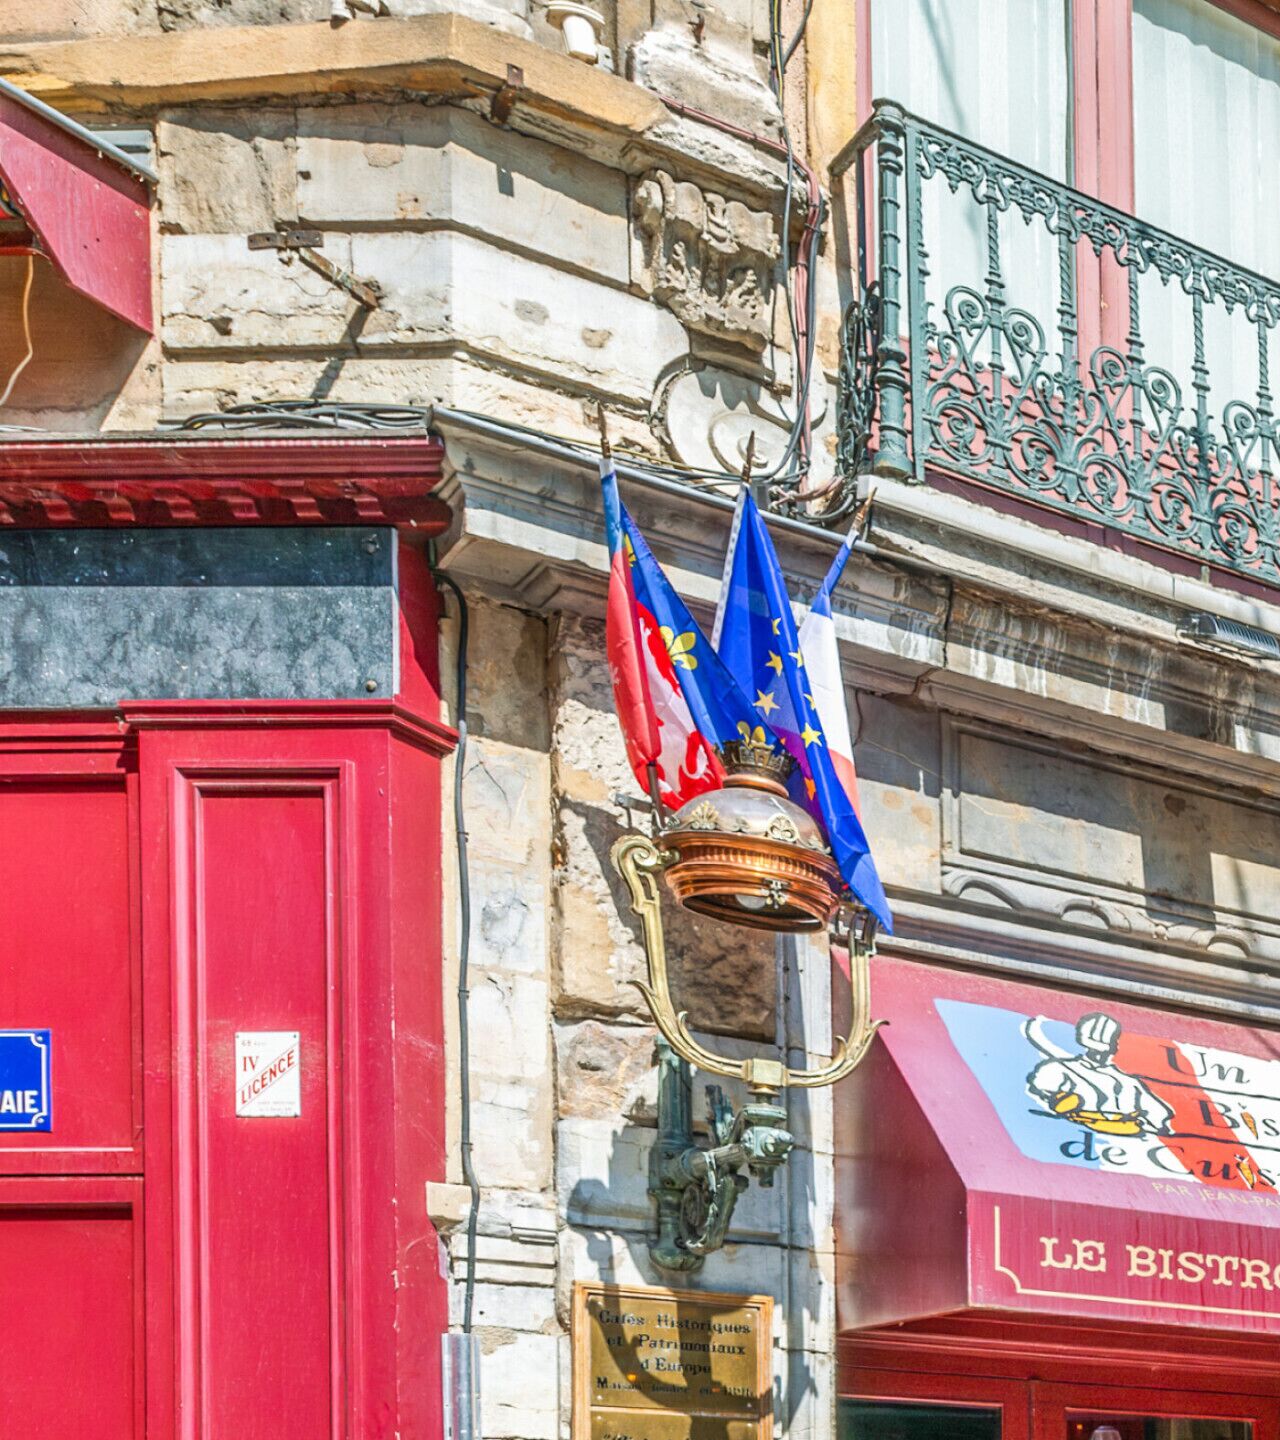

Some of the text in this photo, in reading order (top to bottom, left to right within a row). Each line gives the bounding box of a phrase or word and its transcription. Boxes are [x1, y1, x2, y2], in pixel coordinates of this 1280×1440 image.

[243, 1056, 259, 1071] IV
[1164, 1041, 1250, 1085] Un
[242, 1050, 294, 1104] LICENCE
[0, 1090, 39, 1113] AIE
[1059, 1129, 1128, 1167] de
[1151, 1182, 1192, 1198] PAR
[1040, 1237, 1107, 1273] LE
[599, 1310, 751, 1335] Cafés Historiques
[638, 1333, 746, 1355] Patrimoniaux
